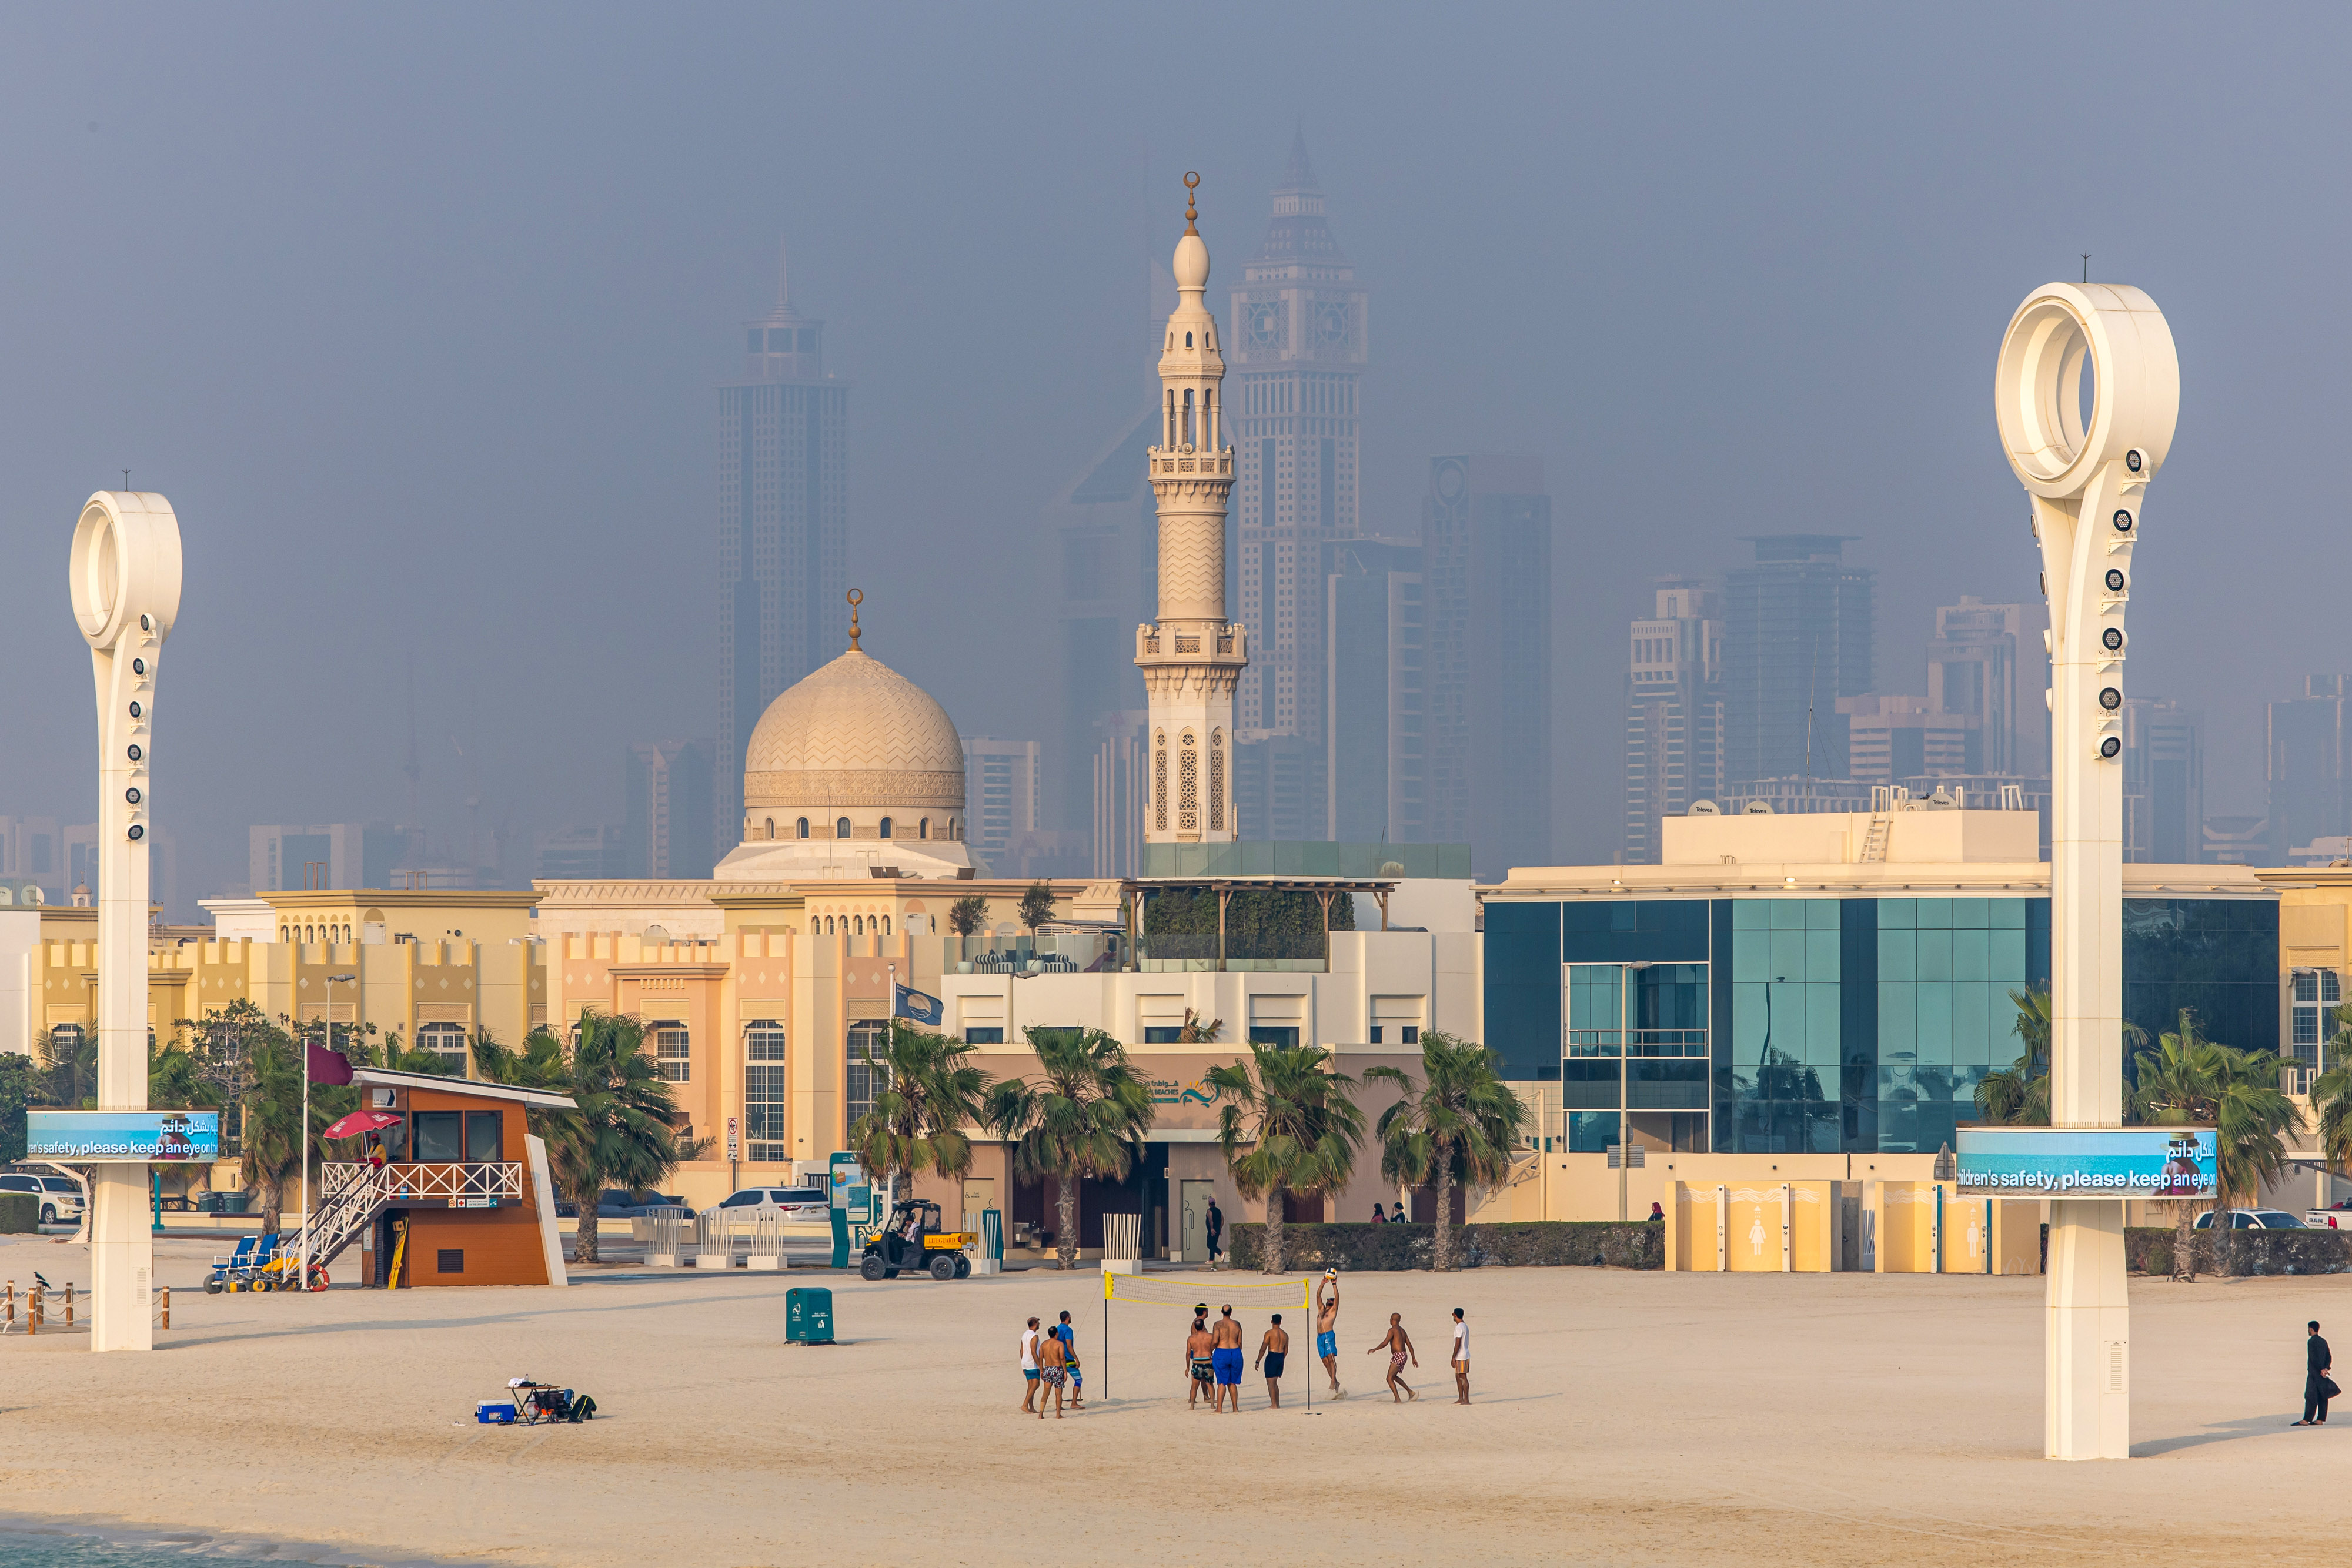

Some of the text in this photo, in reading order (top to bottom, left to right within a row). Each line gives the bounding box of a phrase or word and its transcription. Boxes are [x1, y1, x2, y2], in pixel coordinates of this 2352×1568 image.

[160, 1119, 185, 1136] دائم
[186, 1119, 209, 1135] بشكل
[44, 1141, 79, 1156] safety,
[81, 1141, 128, 1156] please
[130, 1141, 164, 1156] keep
[166, 1144, 181, 1154] an
[182, 1144, 201, 1156] eye
[201, 1144, 211, 1154] on
[2166, 1140, 2216, 1164] بشكل دائم
[2000, 1169, 2059, 1191] safety,
[2062, 1169, 2126, 1190] please
[2129, 1169, 2171, 1190] keep
[2173, 1173, 2190, 1186] an
[2191, 1173, 2209, 1190] eye
[2209, 1173, 2216, 1186] on
